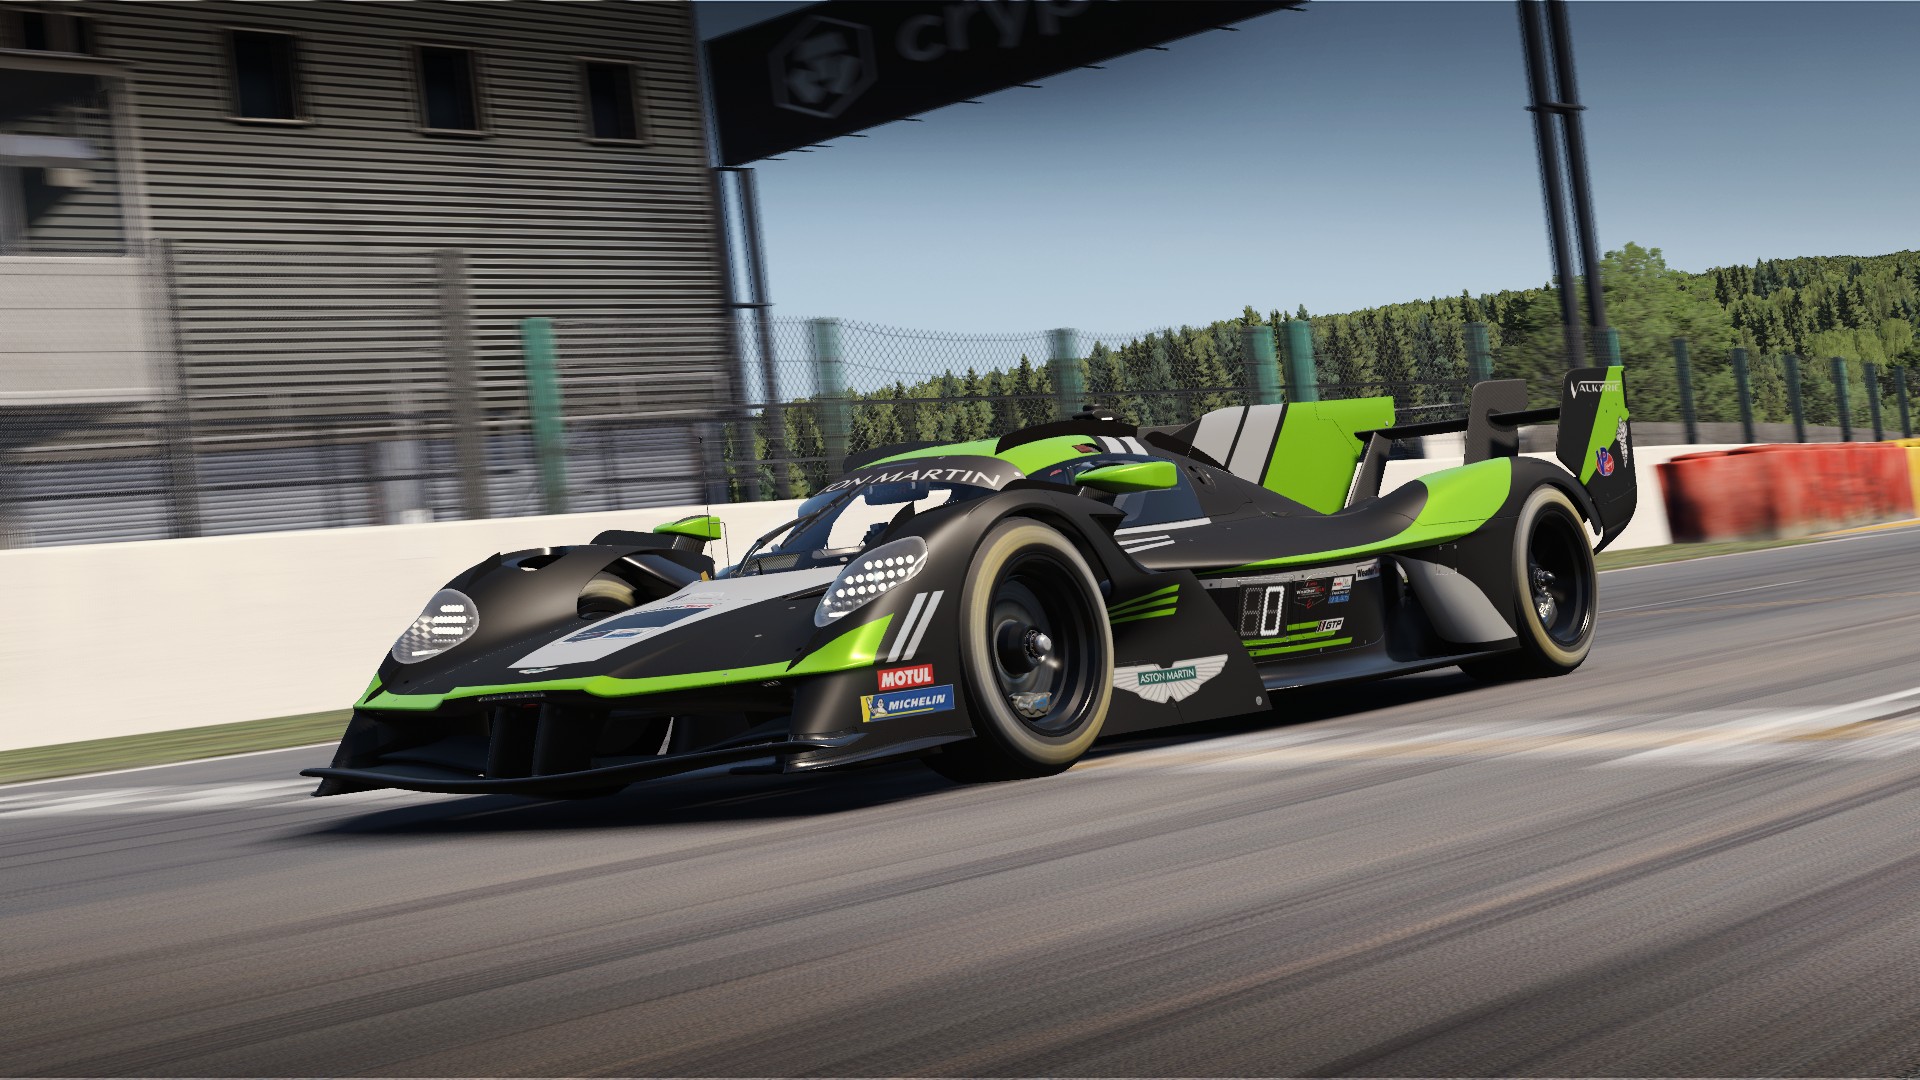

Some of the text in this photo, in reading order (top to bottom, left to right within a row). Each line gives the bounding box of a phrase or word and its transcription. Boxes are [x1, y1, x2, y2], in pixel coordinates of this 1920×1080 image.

[1570, 380, 1621, 399] VALKYRIE
[871, 468, 1000, 487] MARTIN
[1325, 619, 1343, 630] GTP
[881, 667, 932, 688] MOTUL
[1140, 668, 1195, 684] ASTON MARTIN
[888, 694, 946, 711] MICHELIN
